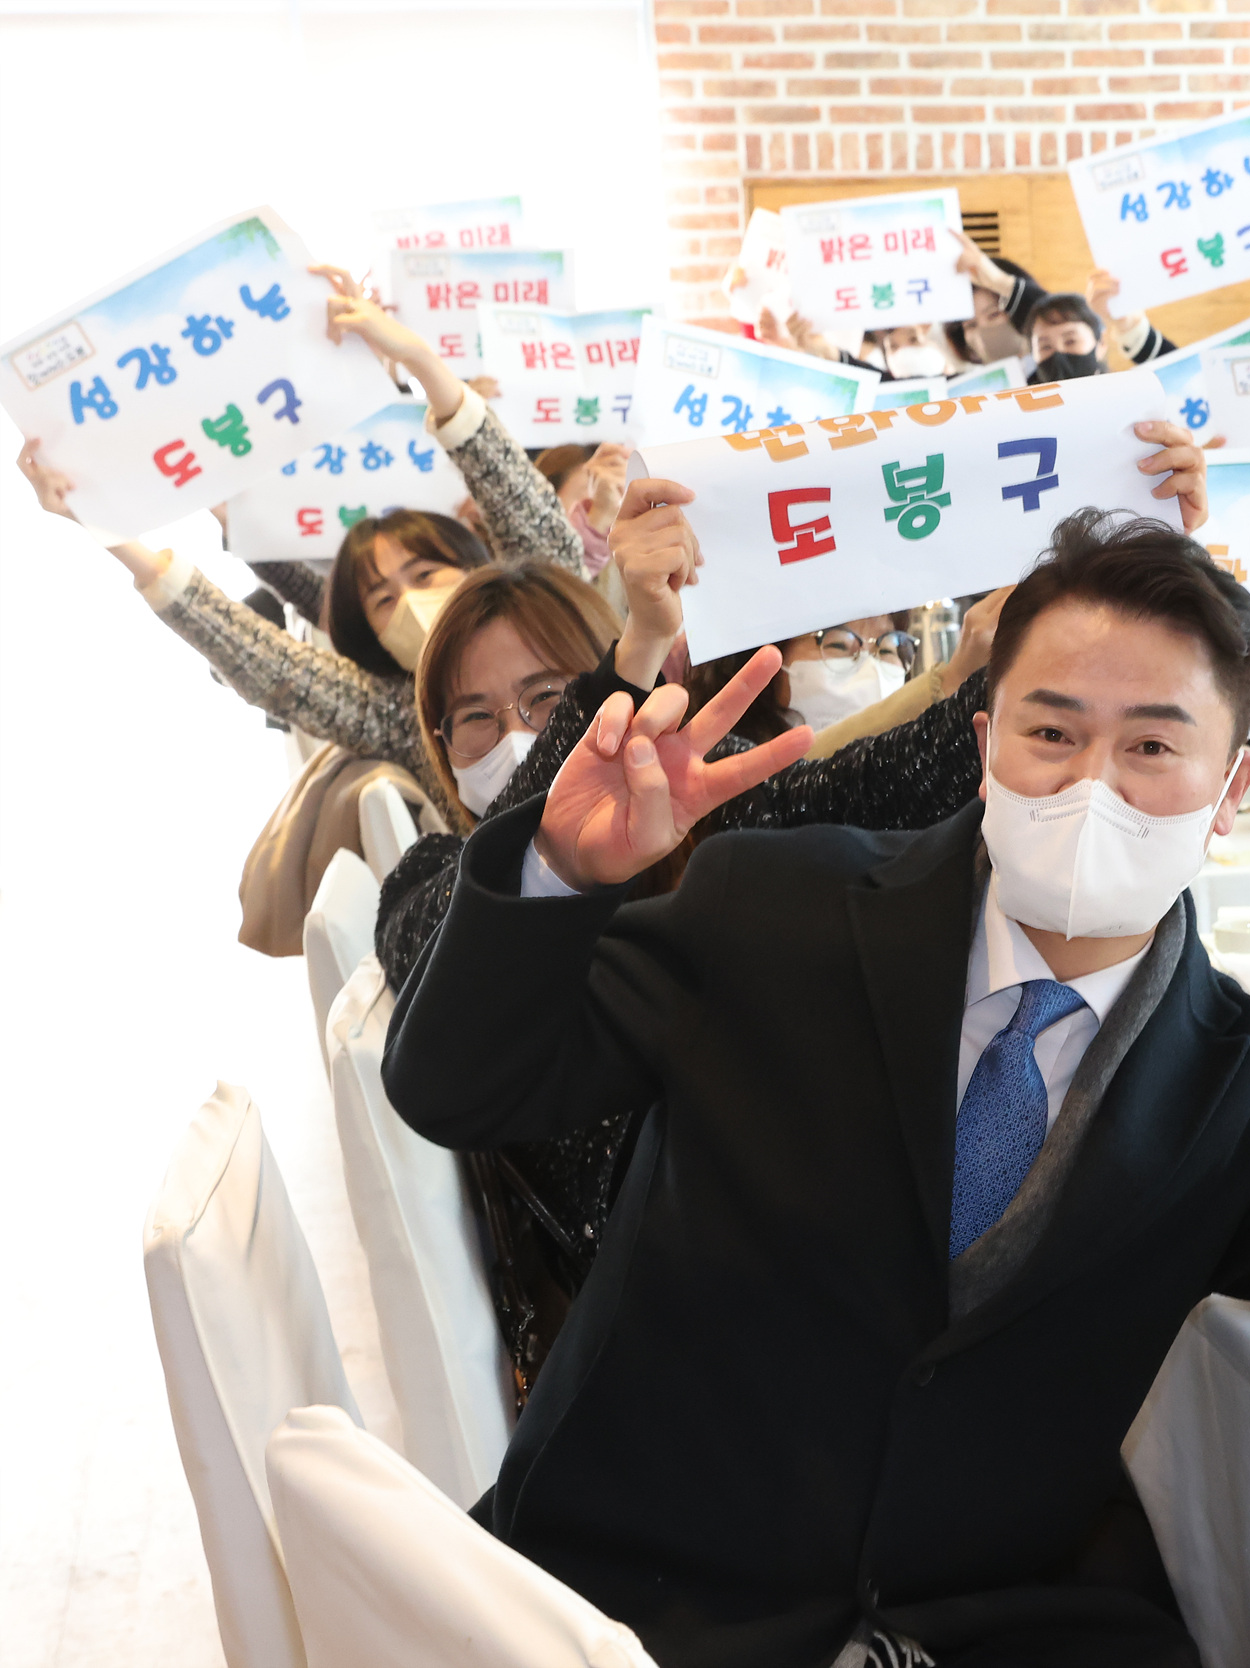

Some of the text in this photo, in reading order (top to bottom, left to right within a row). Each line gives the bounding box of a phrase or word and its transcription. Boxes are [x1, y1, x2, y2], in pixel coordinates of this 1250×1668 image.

[459, 223, 512, 249] 미래
[820, 226, 936, 264] 밝은 미래
[426, 278, 549, 310] 밝은 미래
[834, 277, 932, 312] 도봉구
[69, 283, 291, 425] 성장하는
[521, 341, 574, 370] 밝은
[532, 394, 633, 426] 도봉구
[153, 377, 302, 488] 도봉구
[767, 436, 1060, 567] 도봉구
